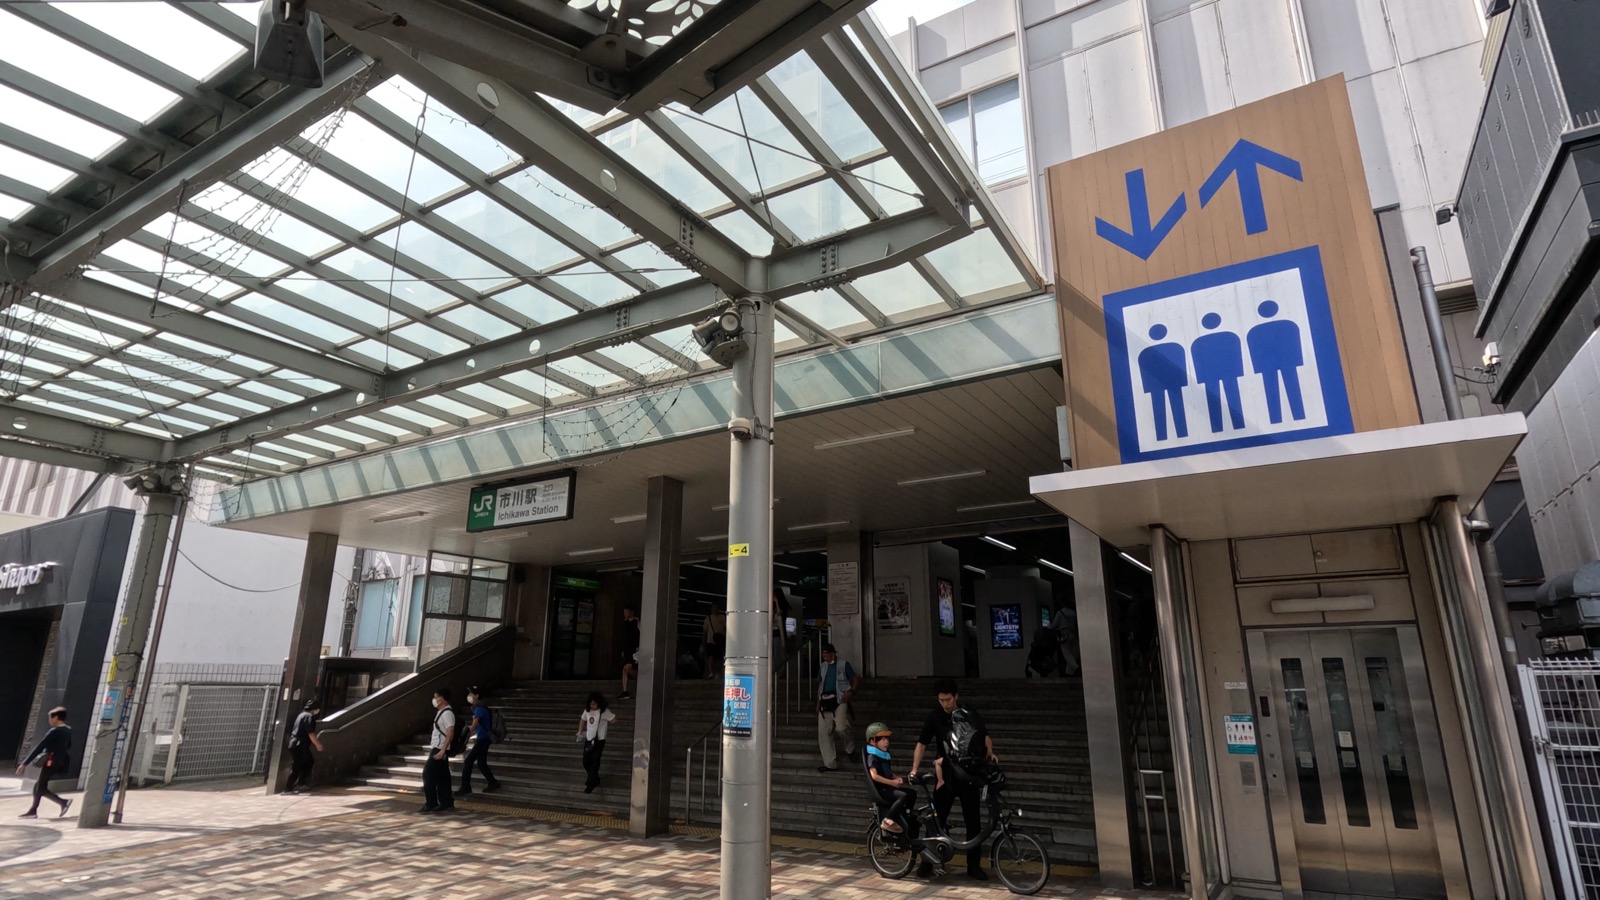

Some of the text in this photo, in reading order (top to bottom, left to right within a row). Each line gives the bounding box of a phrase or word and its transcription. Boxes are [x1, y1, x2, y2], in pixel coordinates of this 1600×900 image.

[473, 494, 493, 512] JR
[499, 488, 537, 509] 市川駅
[498, 505, 559, 521] Ichikawa Station
